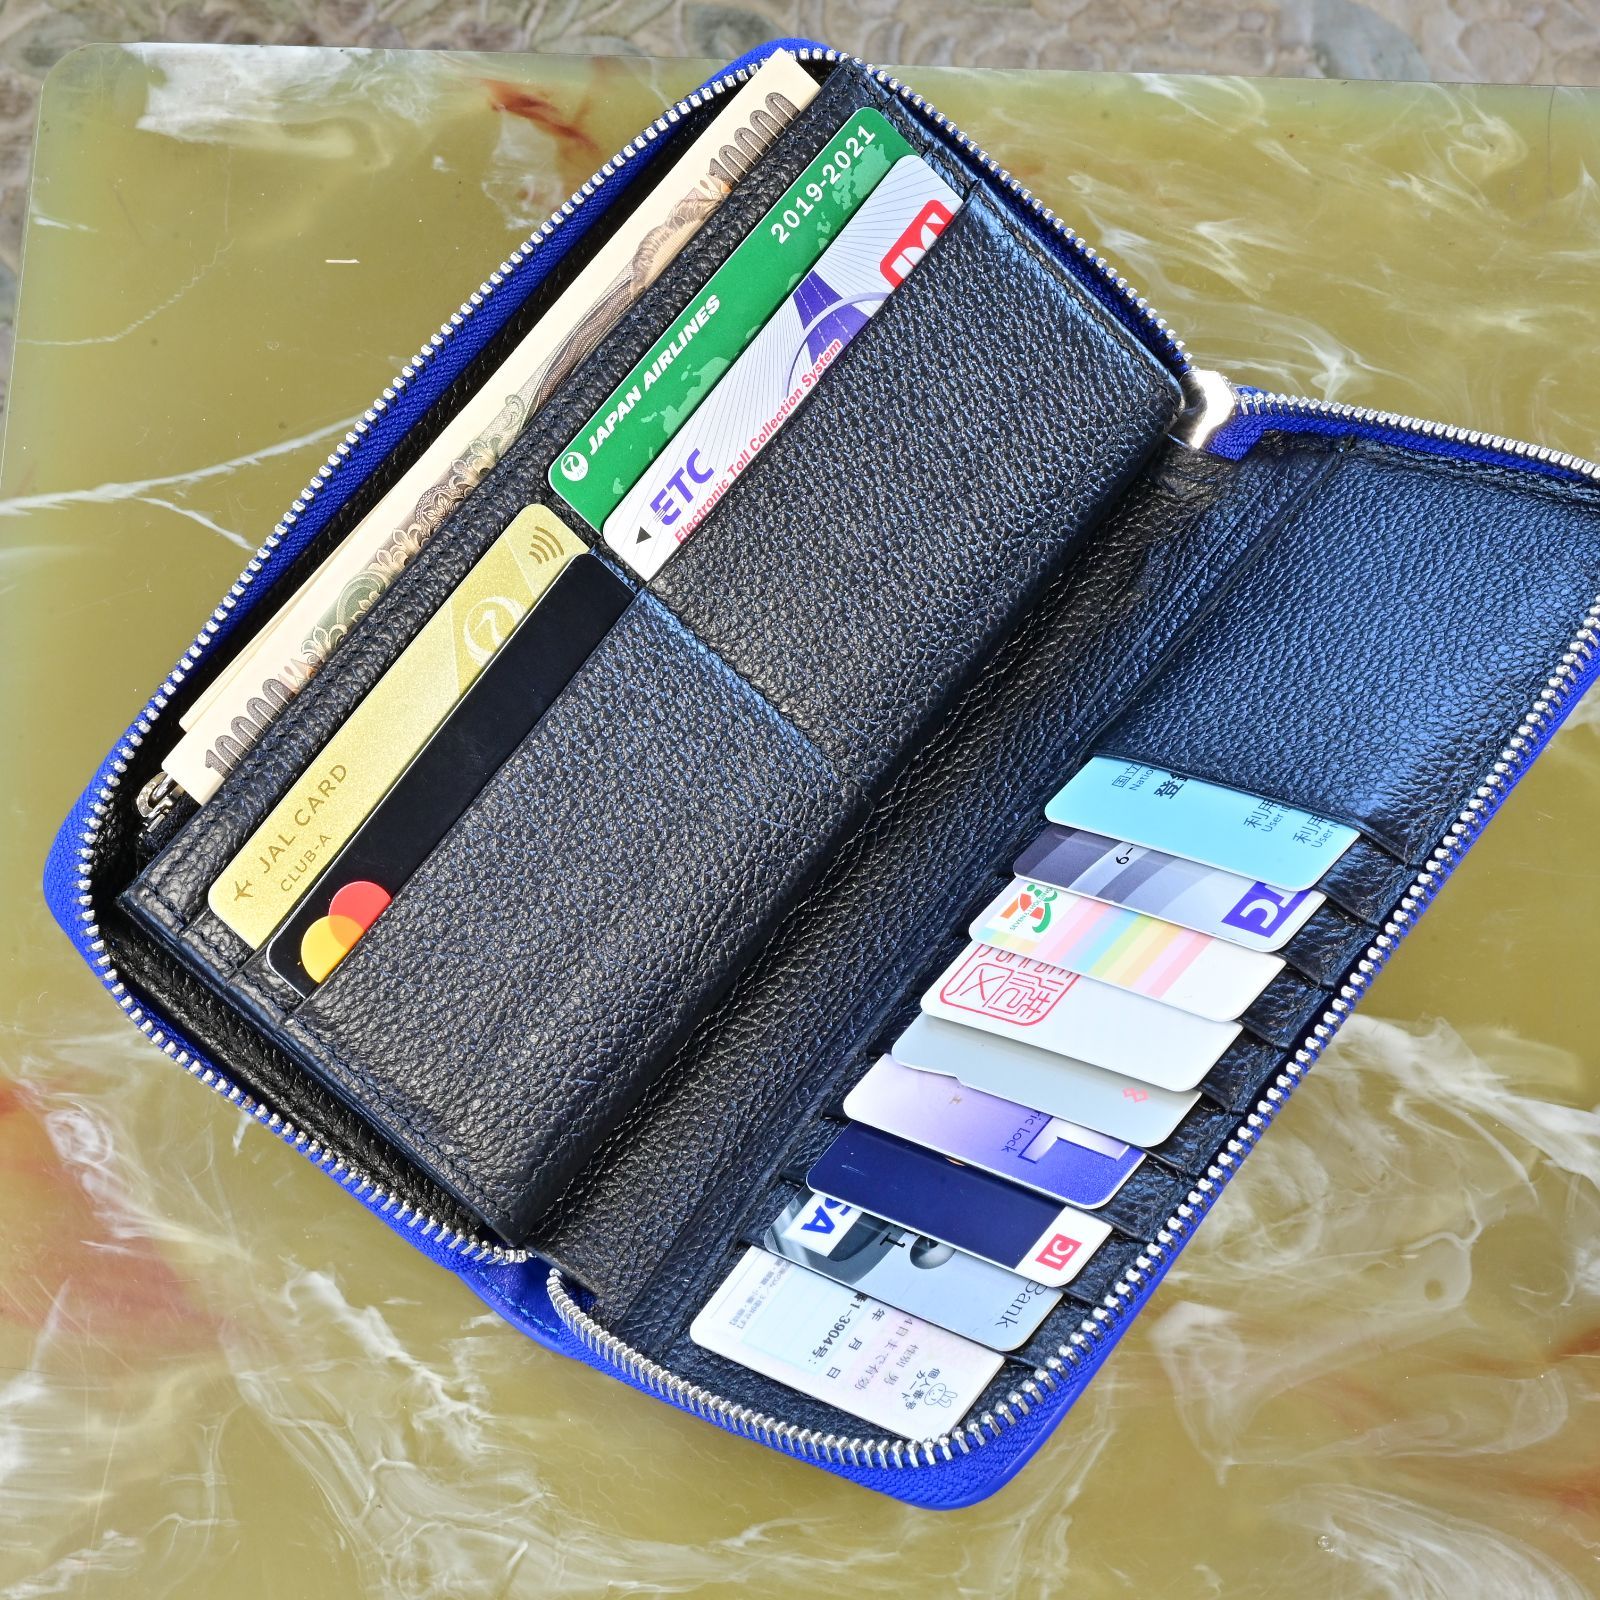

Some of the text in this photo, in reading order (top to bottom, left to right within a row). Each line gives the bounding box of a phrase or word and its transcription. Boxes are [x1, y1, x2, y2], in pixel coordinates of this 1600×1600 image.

[771, 125, 875, 244] 2019-2021
[587, 294, 721, 455] JAPAN AIRLINES
[674, 339, 842, 544] Electronic Toll Collection System
[650, 448, 714, 525] ETC
[257, 764, 347, 874] JAL CARD
[280, 834, 332, 892] CLUB-A
[1000, 1127, 1029, 1153] Lock
[1045, 1238, 1075, 1267] IC
[994, 1281, 1048, 1329] Bank
